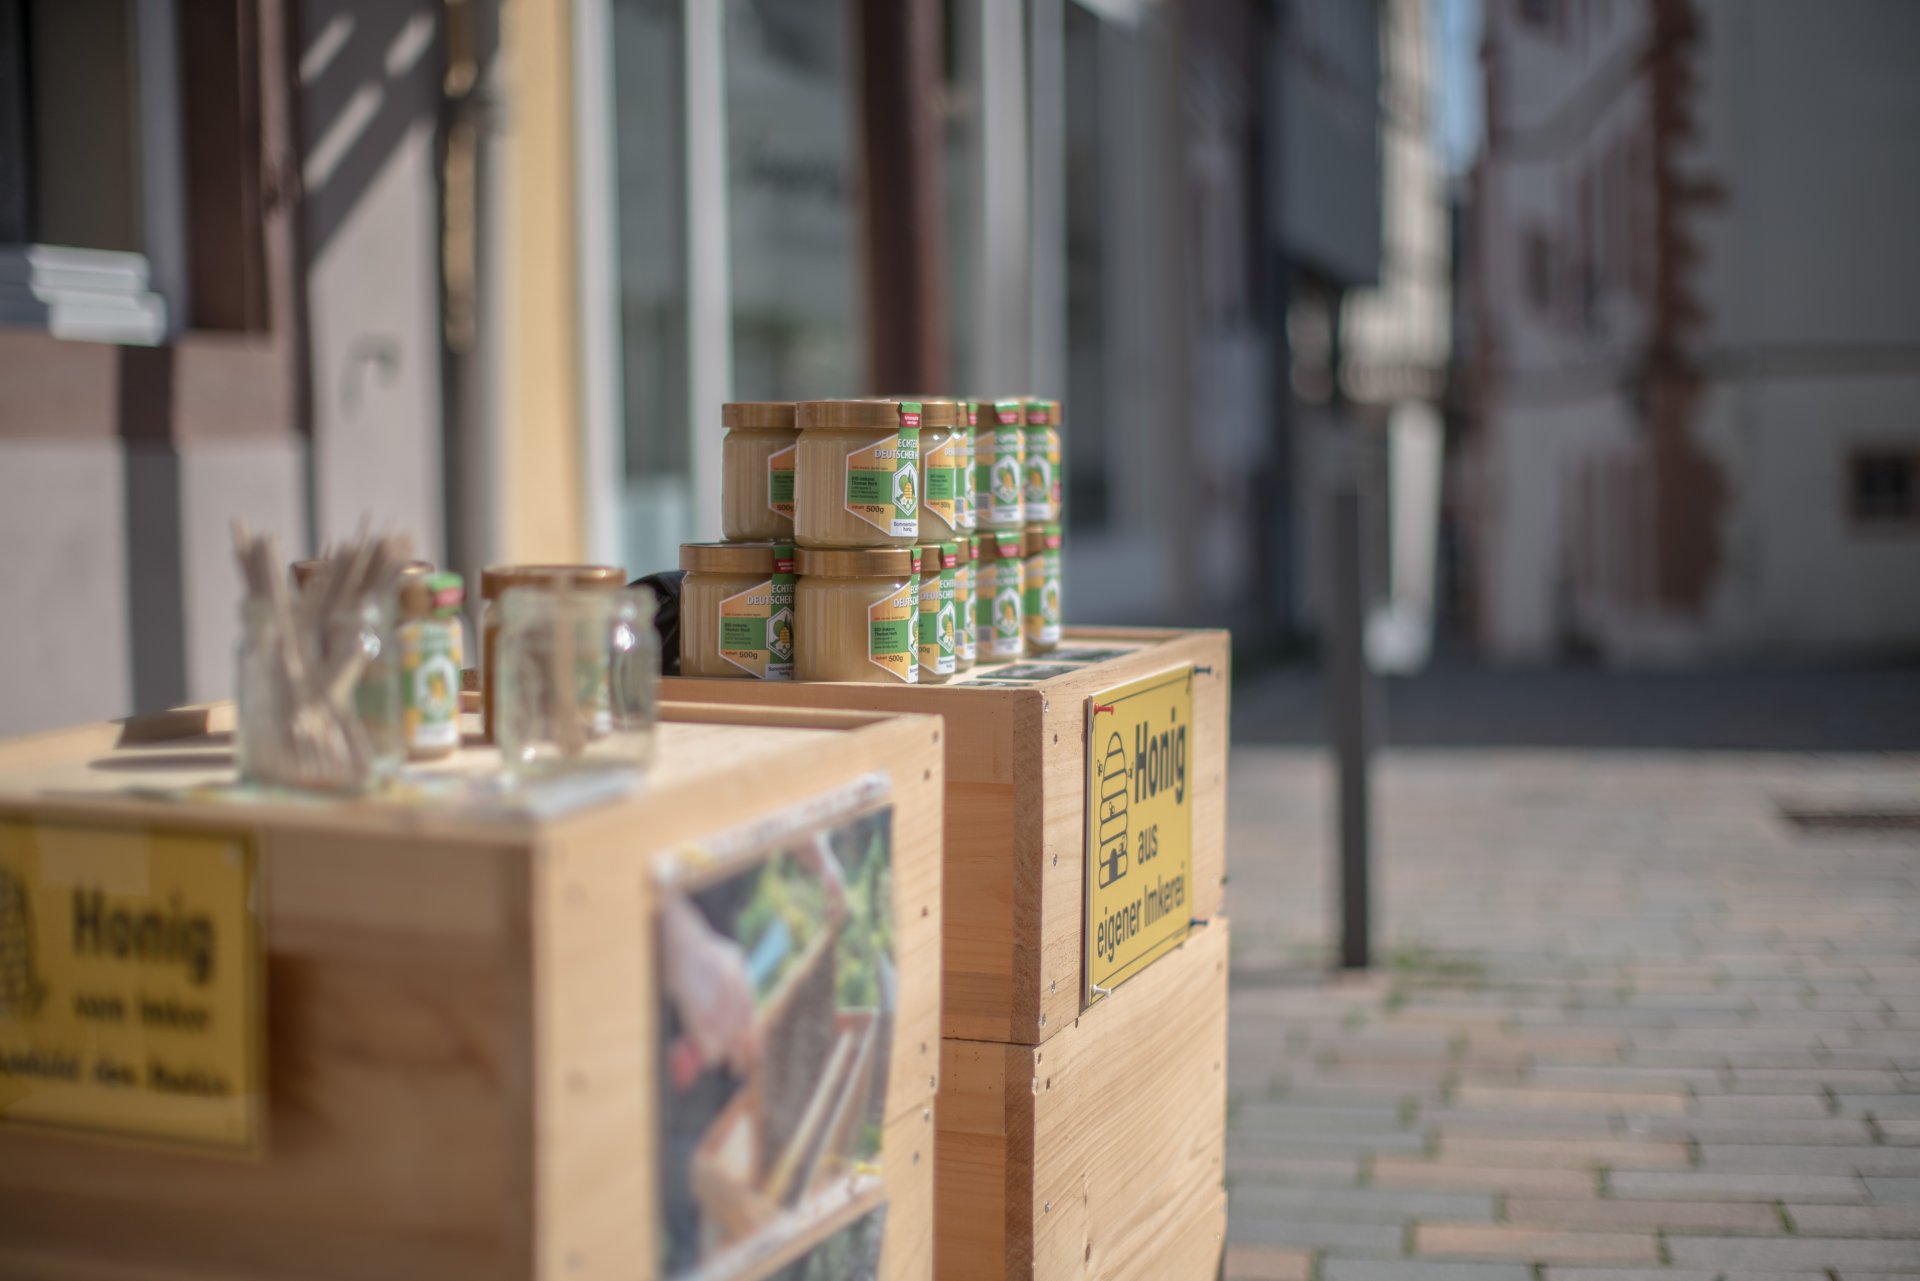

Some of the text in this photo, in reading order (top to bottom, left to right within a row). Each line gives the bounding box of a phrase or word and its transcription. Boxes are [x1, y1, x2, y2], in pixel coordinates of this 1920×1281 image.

[866, 505, 885, 514] 500g
[739, 651, 758, 659] 500g
[888, 654, 904, 662] 500g
[1134, 706, 1186, 806] Honig
[1137, 823, 1158, 865] aus
[1097, 862, 1185, 963] eigener Imkerei
[71, 882, 215, 989] Honig
